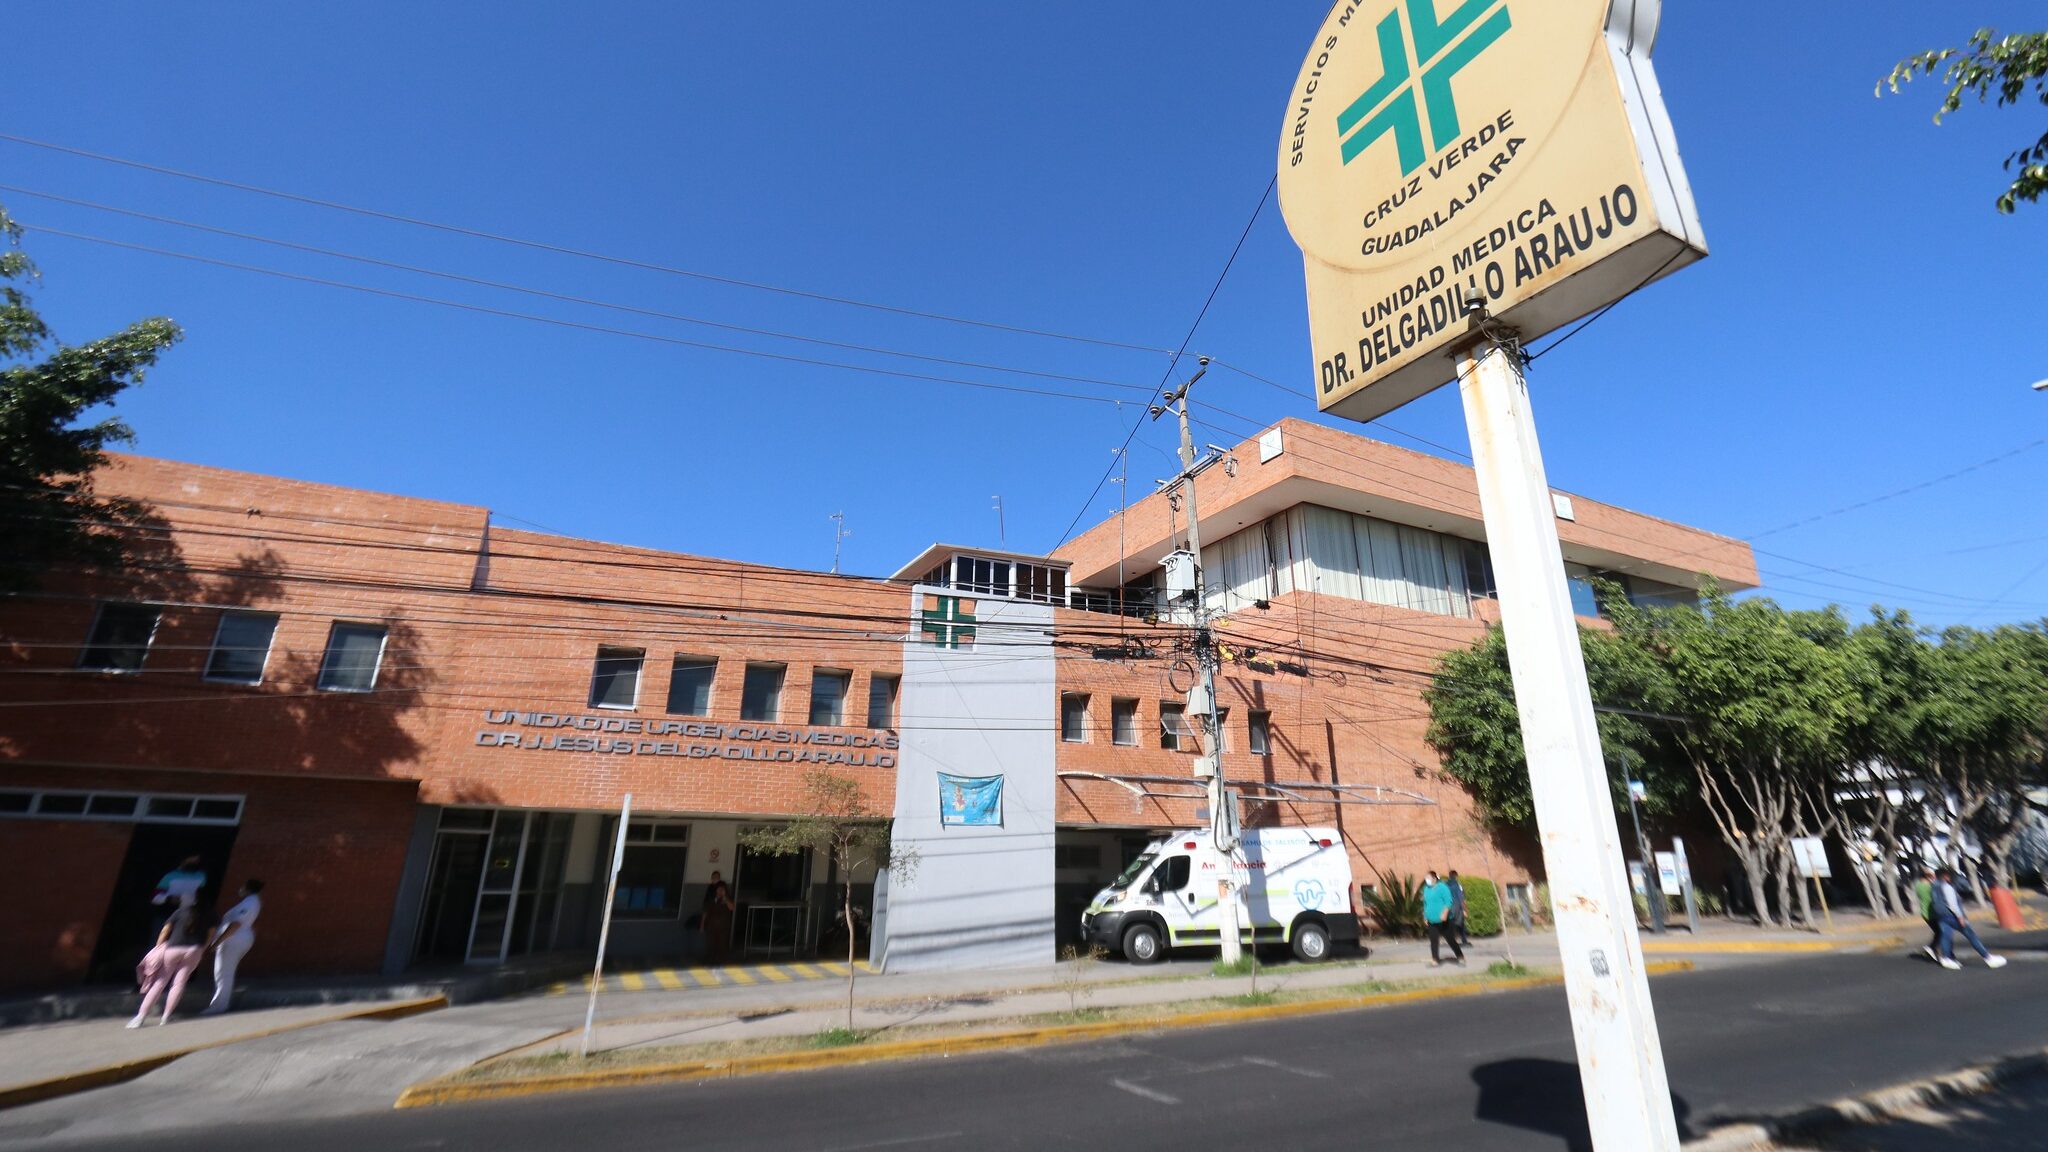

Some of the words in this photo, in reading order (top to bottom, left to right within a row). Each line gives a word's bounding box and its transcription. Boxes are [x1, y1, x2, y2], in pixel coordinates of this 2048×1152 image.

[1291, 35, 1338, 168] SERVICIOS
[1361, 136, 1527, 256] GUADALAJARA
[1363, 178, 1423, 229] CRUZ
[1428, 109, 1515, 179] VERDE
[1321, 353, 1355, 394] DR.
[1514, 184, 1638, 288] ARAUJO
[1362, 265, 1445, 329] UNIDAD
[1452, 198, 1557, 275] MEDICA
[475, 731, 522, 748] DR
[636, 740, 794, 763] DELGADILLO
[796, 749, 895, 768] ARAUJO
[484, 710, 601, 730] UNIDAD
[603, 718, 643, 734] DE
[645, 720, 791, 743] URGENCIAS
[794, 731, 900, 750] MEDICAS
[1201, 859, 1268, 870] Amlancia
